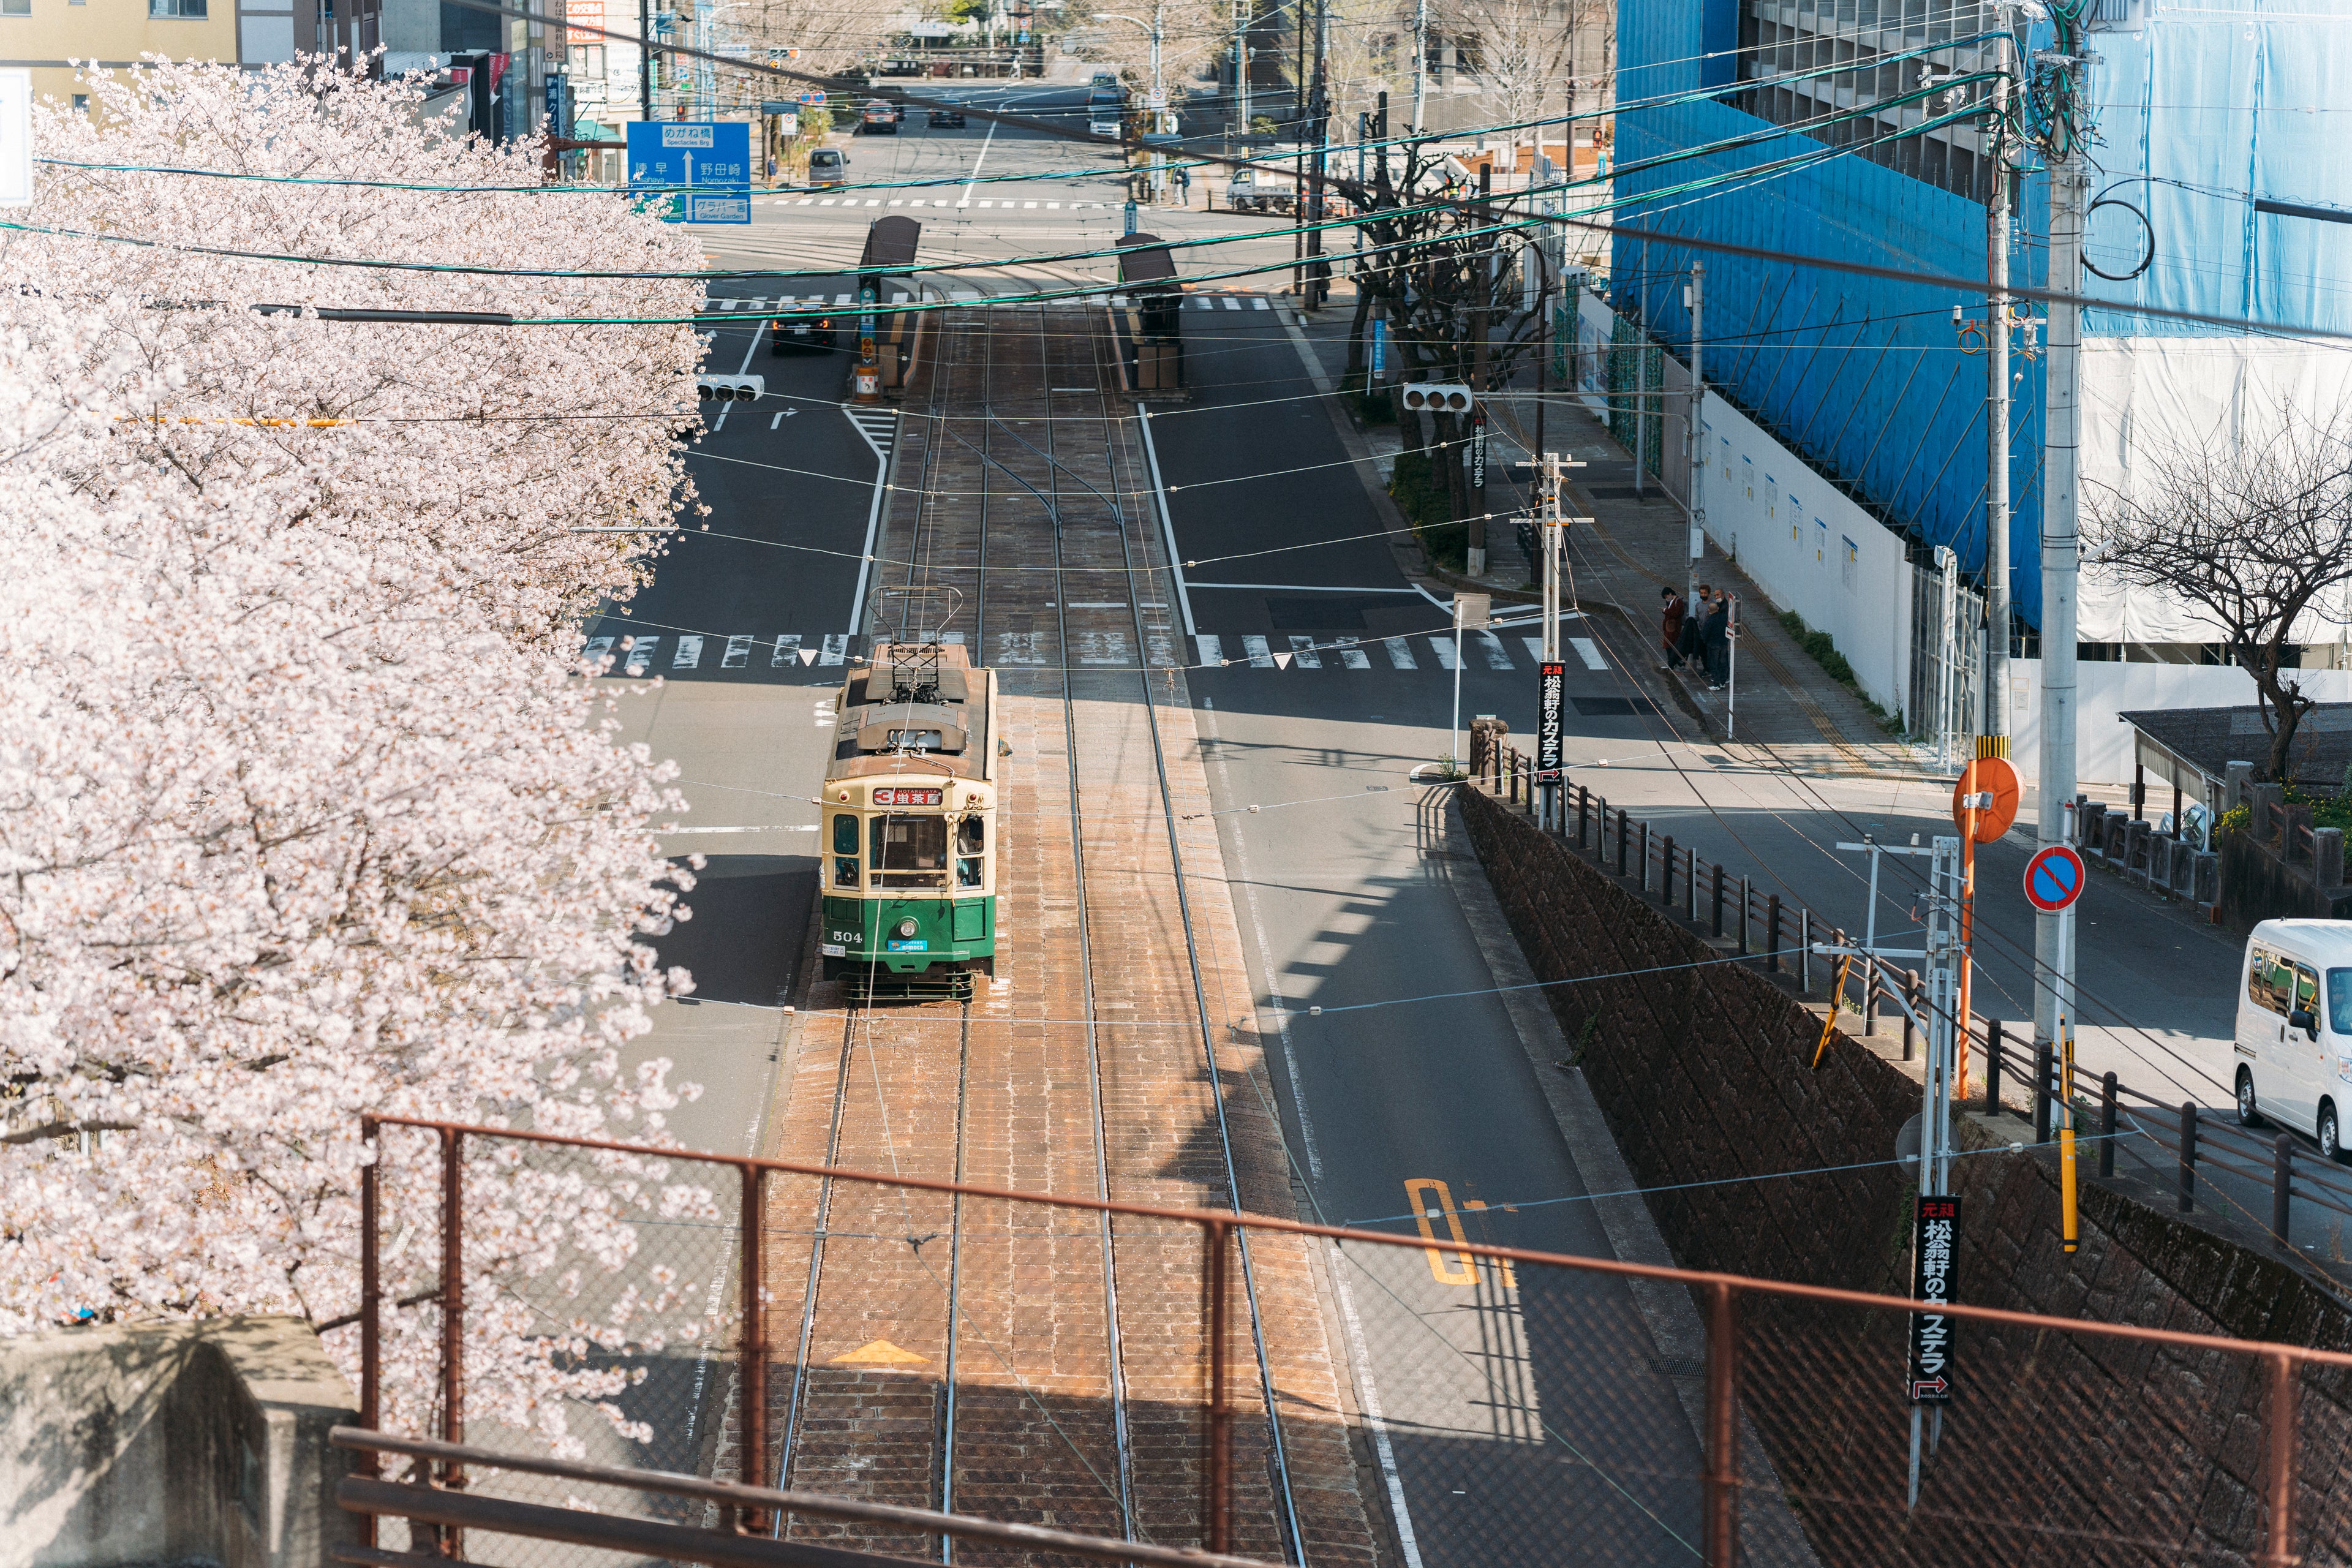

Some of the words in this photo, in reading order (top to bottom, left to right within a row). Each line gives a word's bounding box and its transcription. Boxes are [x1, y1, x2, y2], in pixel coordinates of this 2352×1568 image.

[665, 128, 711, 138] めがね橋
[700, 163, 741, 176] 野母崎
[698, 202, 745, 213] グラバー園
[1542, 666, 1562, 674] 元祖
[1542, 675, 1561, 767] 松翁軒のカステラ
[874, 790, 895, 804] 3
[897, 793, 939, 804] 蛍茶屋
[833, 931, 862, 943] 504
[1921, 1202, 1955, 1218] 元祖
